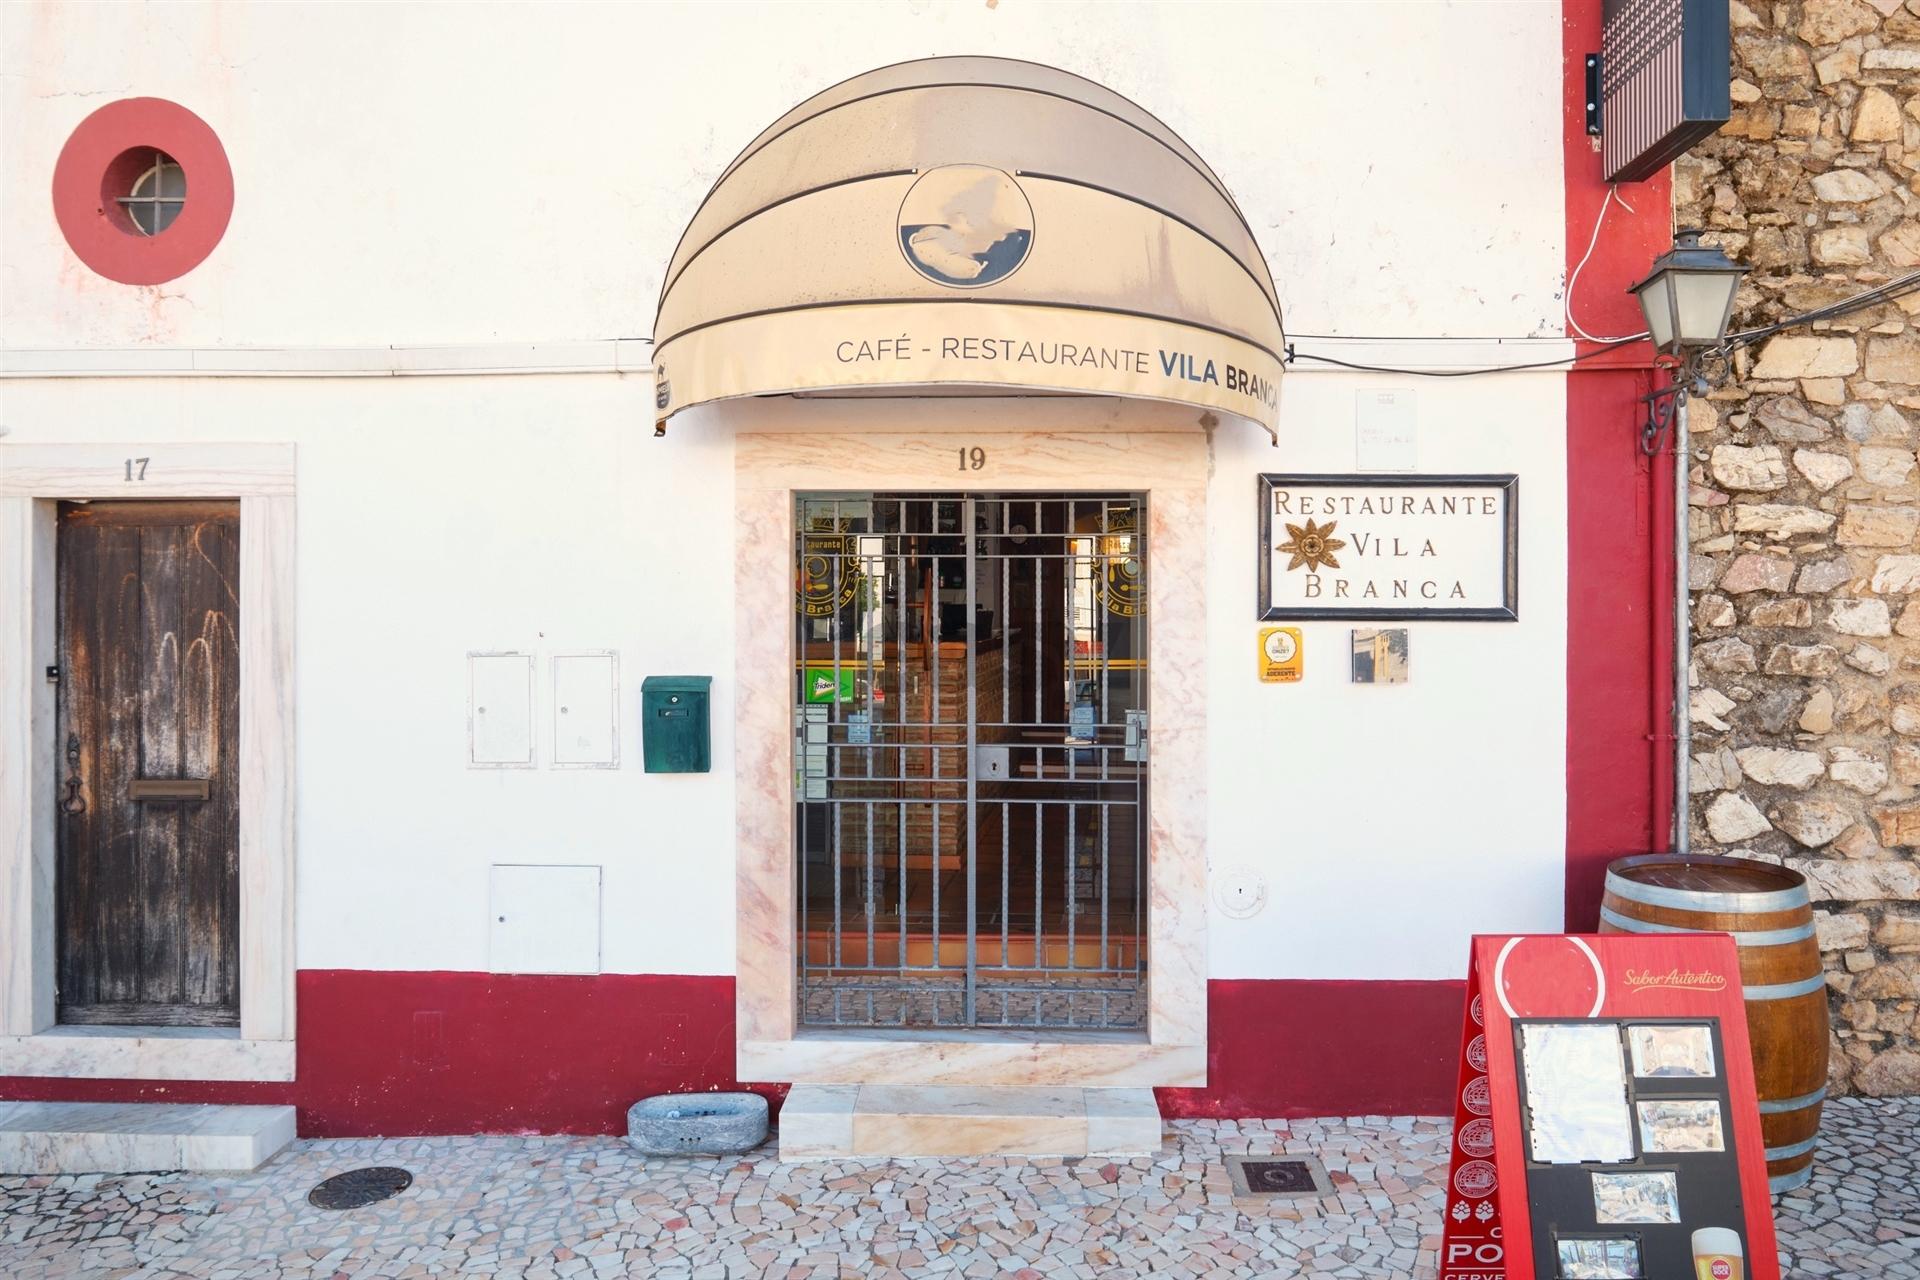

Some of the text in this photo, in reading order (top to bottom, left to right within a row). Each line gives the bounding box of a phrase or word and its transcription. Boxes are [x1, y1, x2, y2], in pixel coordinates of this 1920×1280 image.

[836, 333, 911, 363] CAFÉ
[942, 337, 1150, 374] RESTAURANTE
[1158, 349, 1219, 386] VILA
[1226, 364, 1278, 412] BRANCA
[124, 457, 150, 481] 17
[958, 446, 986, 471] 19
[1274, 491, 1497, 515] RESTAURANTE
[1350, 533, 1437, 556] VILA
[1305, 574, 1466, 599] BRANCA
[806, 589, 853, 613] Braca
[1624, 969, 1663, 985] Sabor
